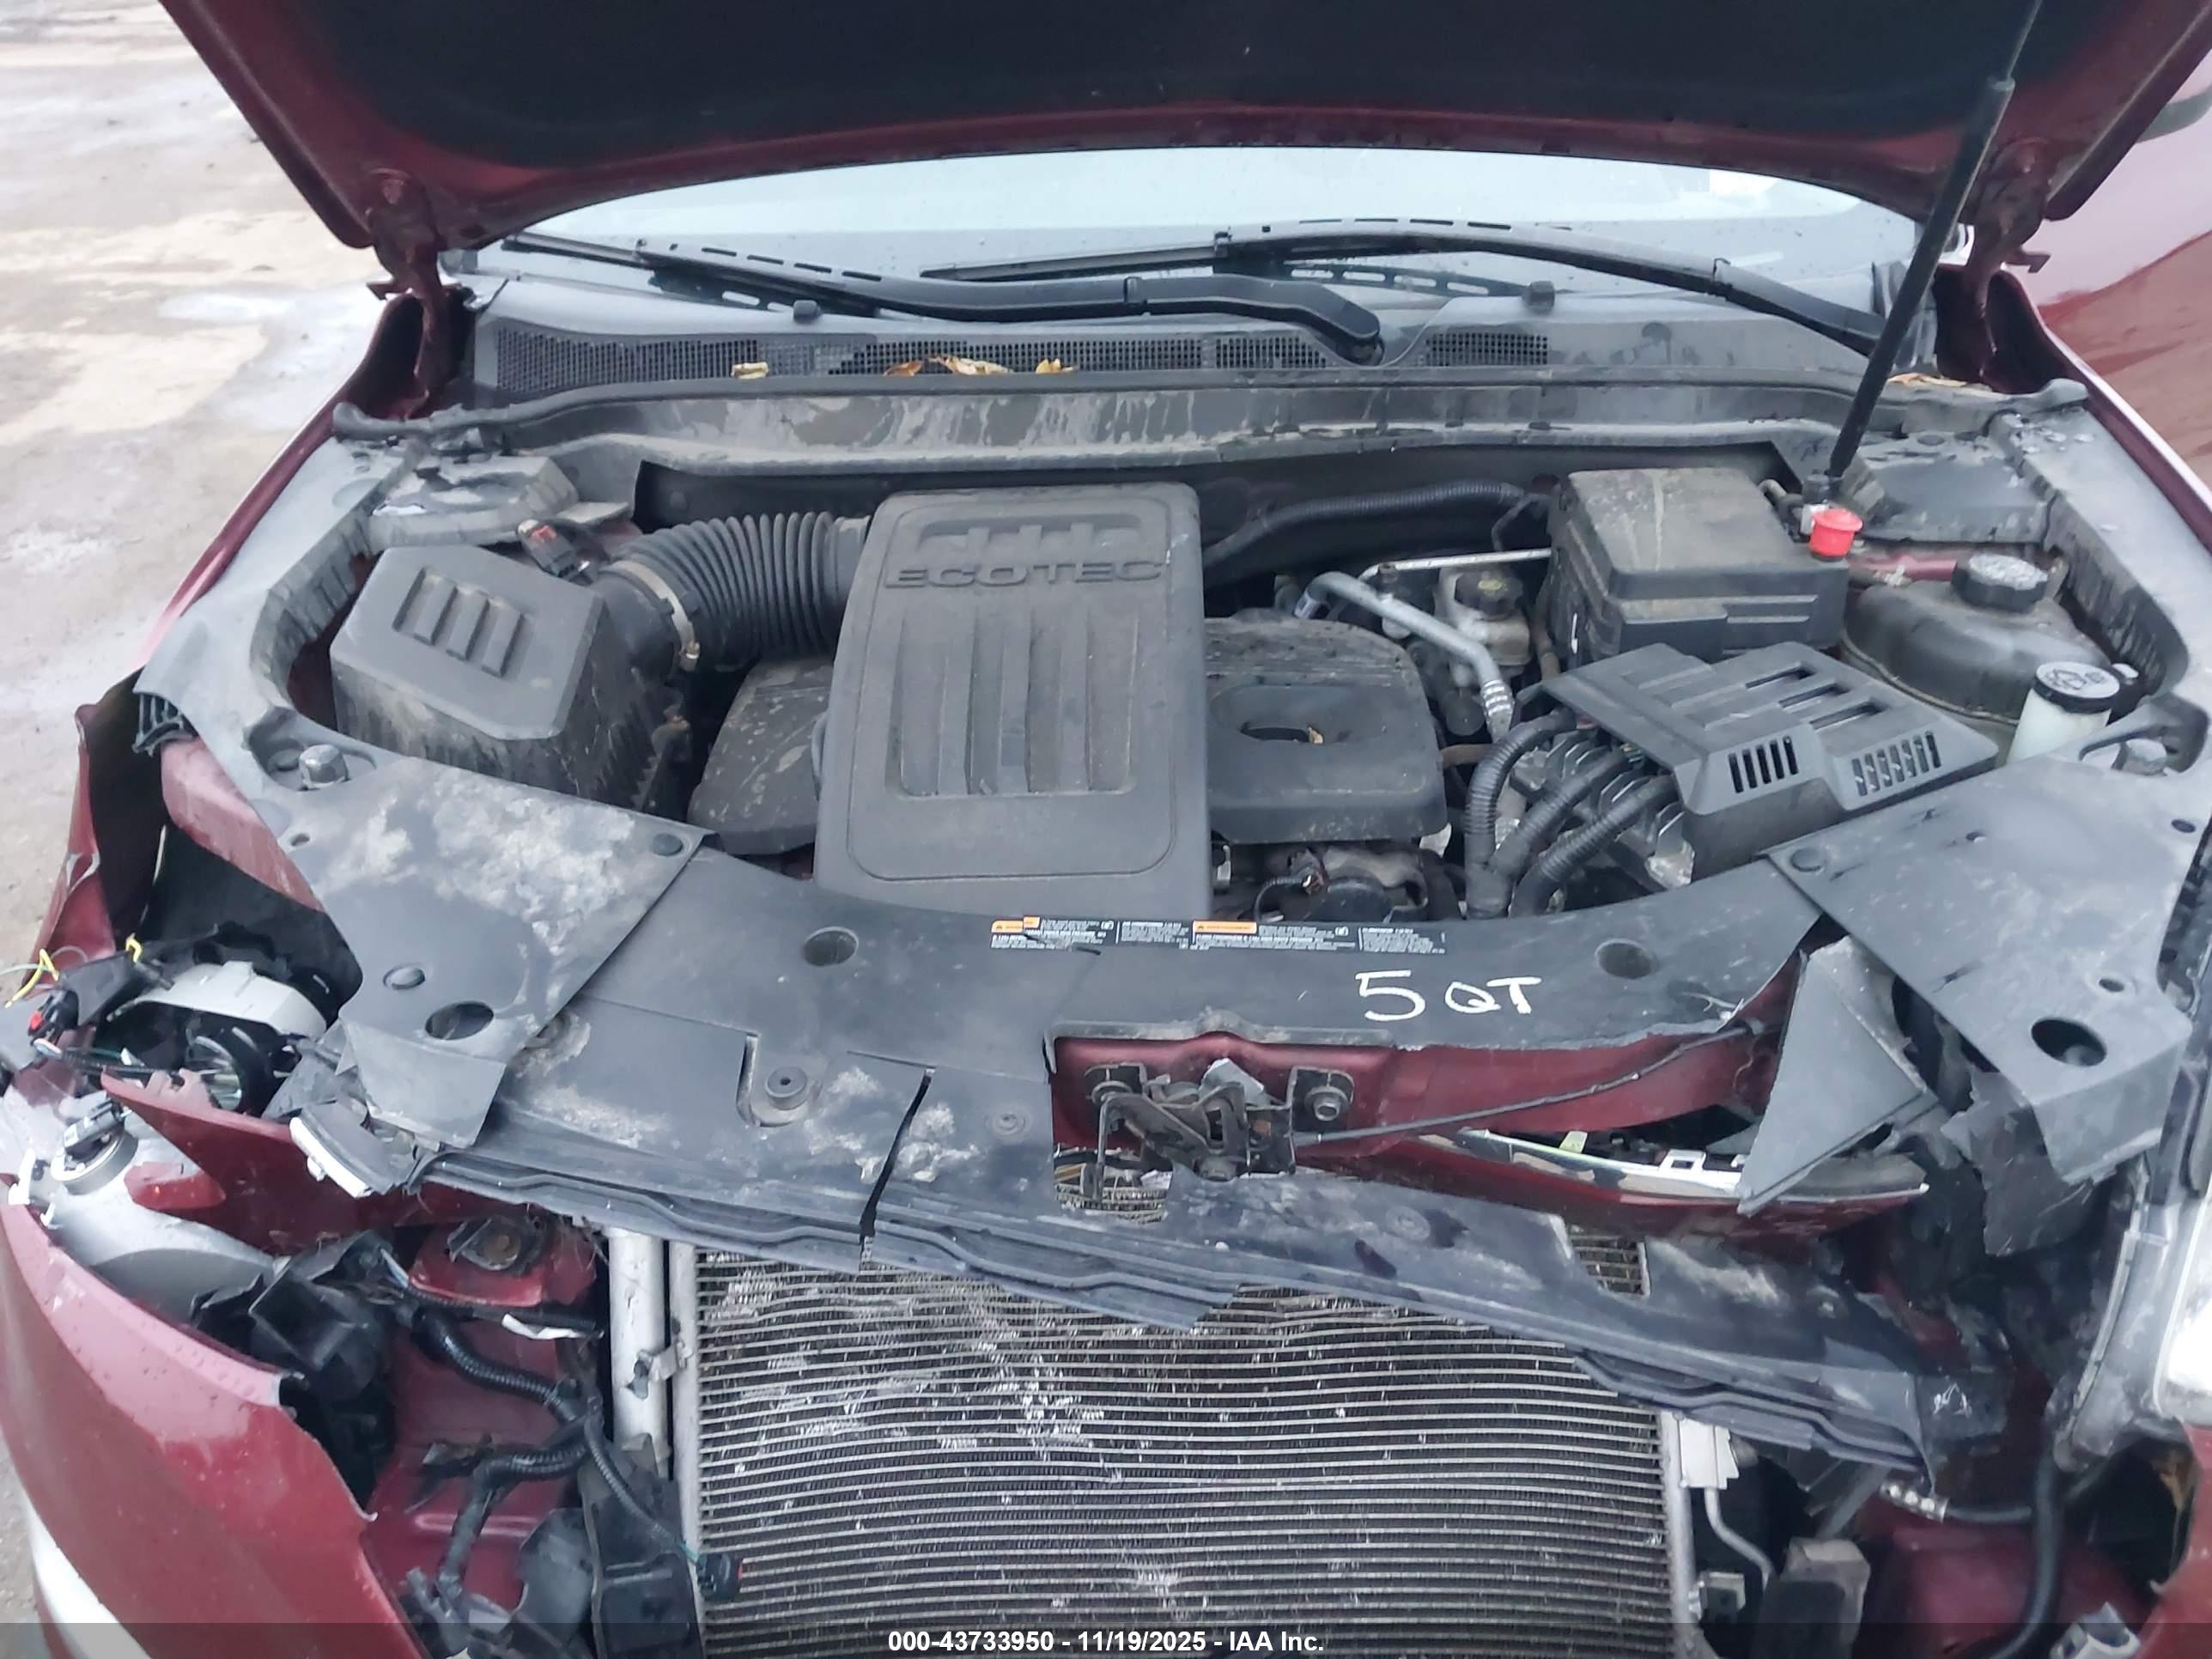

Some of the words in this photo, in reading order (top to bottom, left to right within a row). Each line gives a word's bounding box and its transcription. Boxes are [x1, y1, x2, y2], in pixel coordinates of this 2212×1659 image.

[885, 559, 1164, 589] ECOTEC
[1355, 969, 1426, 1021] 5
[1444, 976, 1542, 1014] QT
